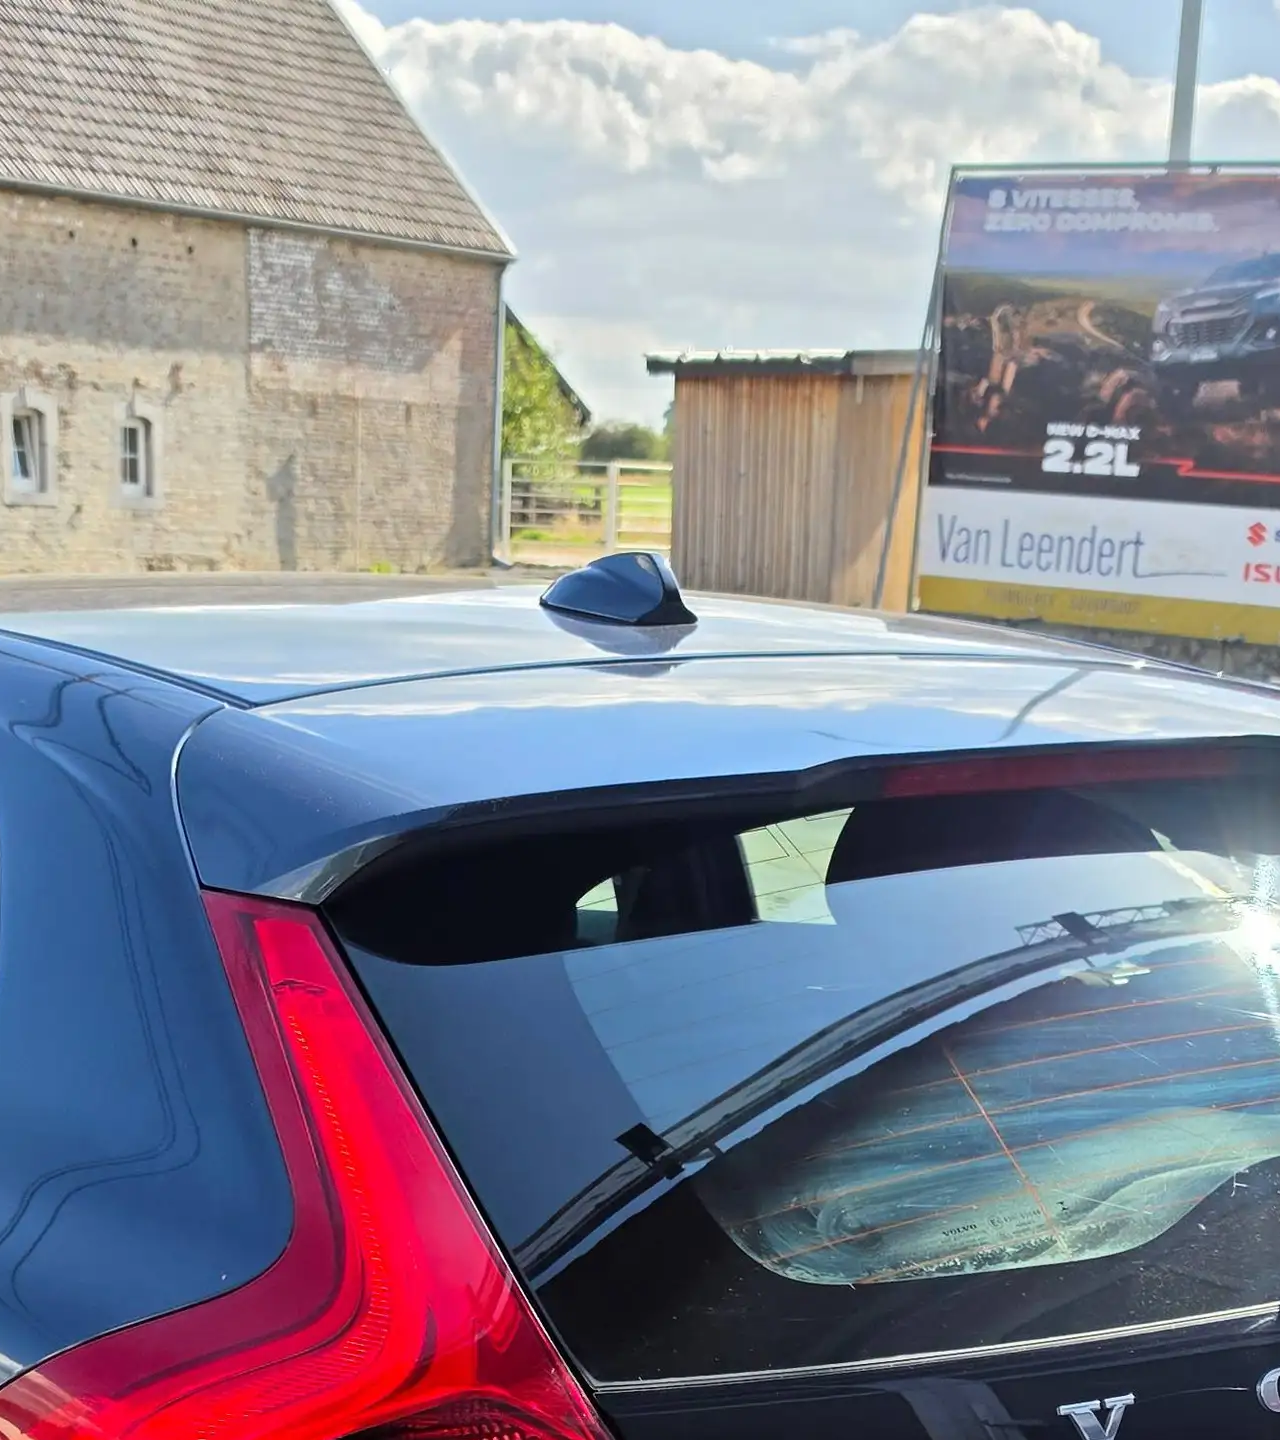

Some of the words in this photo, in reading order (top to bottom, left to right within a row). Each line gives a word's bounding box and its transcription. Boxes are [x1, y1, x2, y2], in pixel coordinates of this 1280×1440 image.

[1046, 422, 1085, 437] NEW
[1086, 424, 1142, 440] D-MAX
[1041, 439, 1140, 477] 2.2L
[937, 513, 992, 565] Van
[1000, 518, 1146, 579] Leendert
